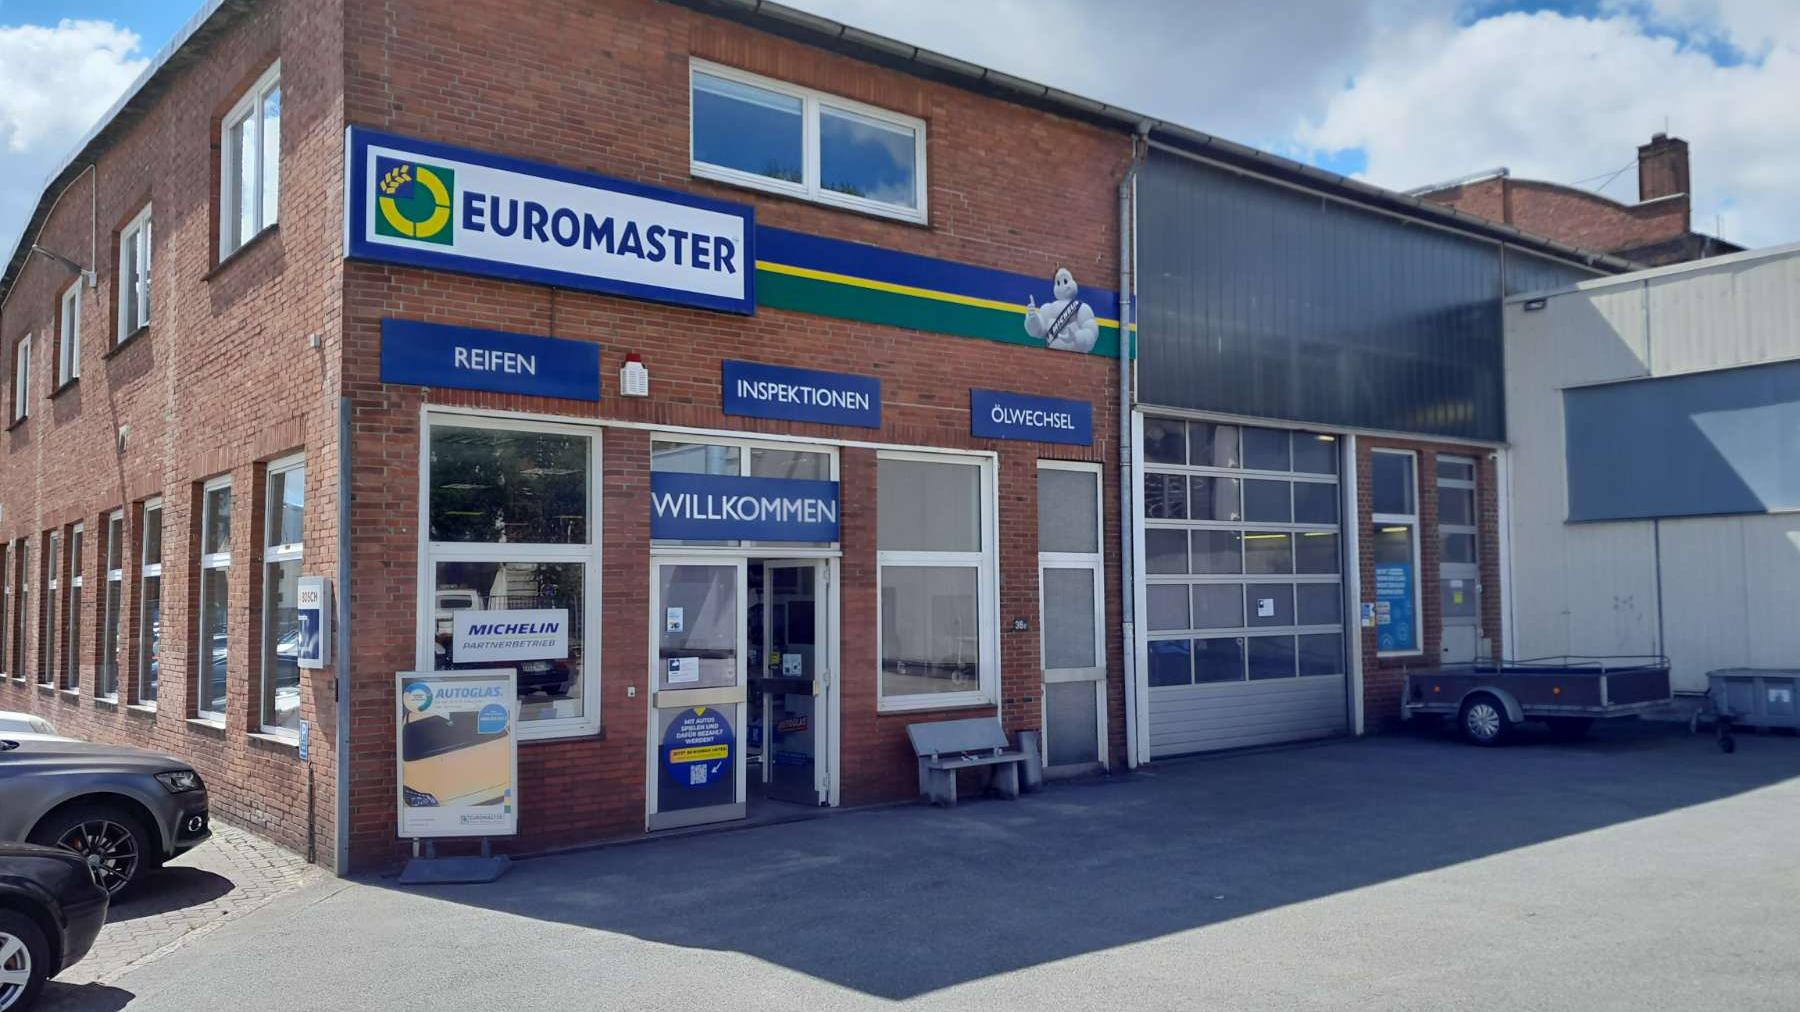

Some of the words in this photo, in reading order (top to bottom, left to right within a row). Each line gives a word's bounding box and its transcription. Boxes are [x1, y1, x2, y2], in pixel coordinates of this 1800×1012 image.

[463, 191, 736, 274] EUROMASTER
[454, 346, 536, 376] REIFEN
[737, 379, 869, 411] INSPEKTIONEN
[991, 403, 1075, 429] ÖLWECHSEL
[651, 492, 837, 523] WILLKOMMEN
[468, 622, 560, 636] MICHELIN
[462, 639, 556, 650] PARTNERBETRIEB
